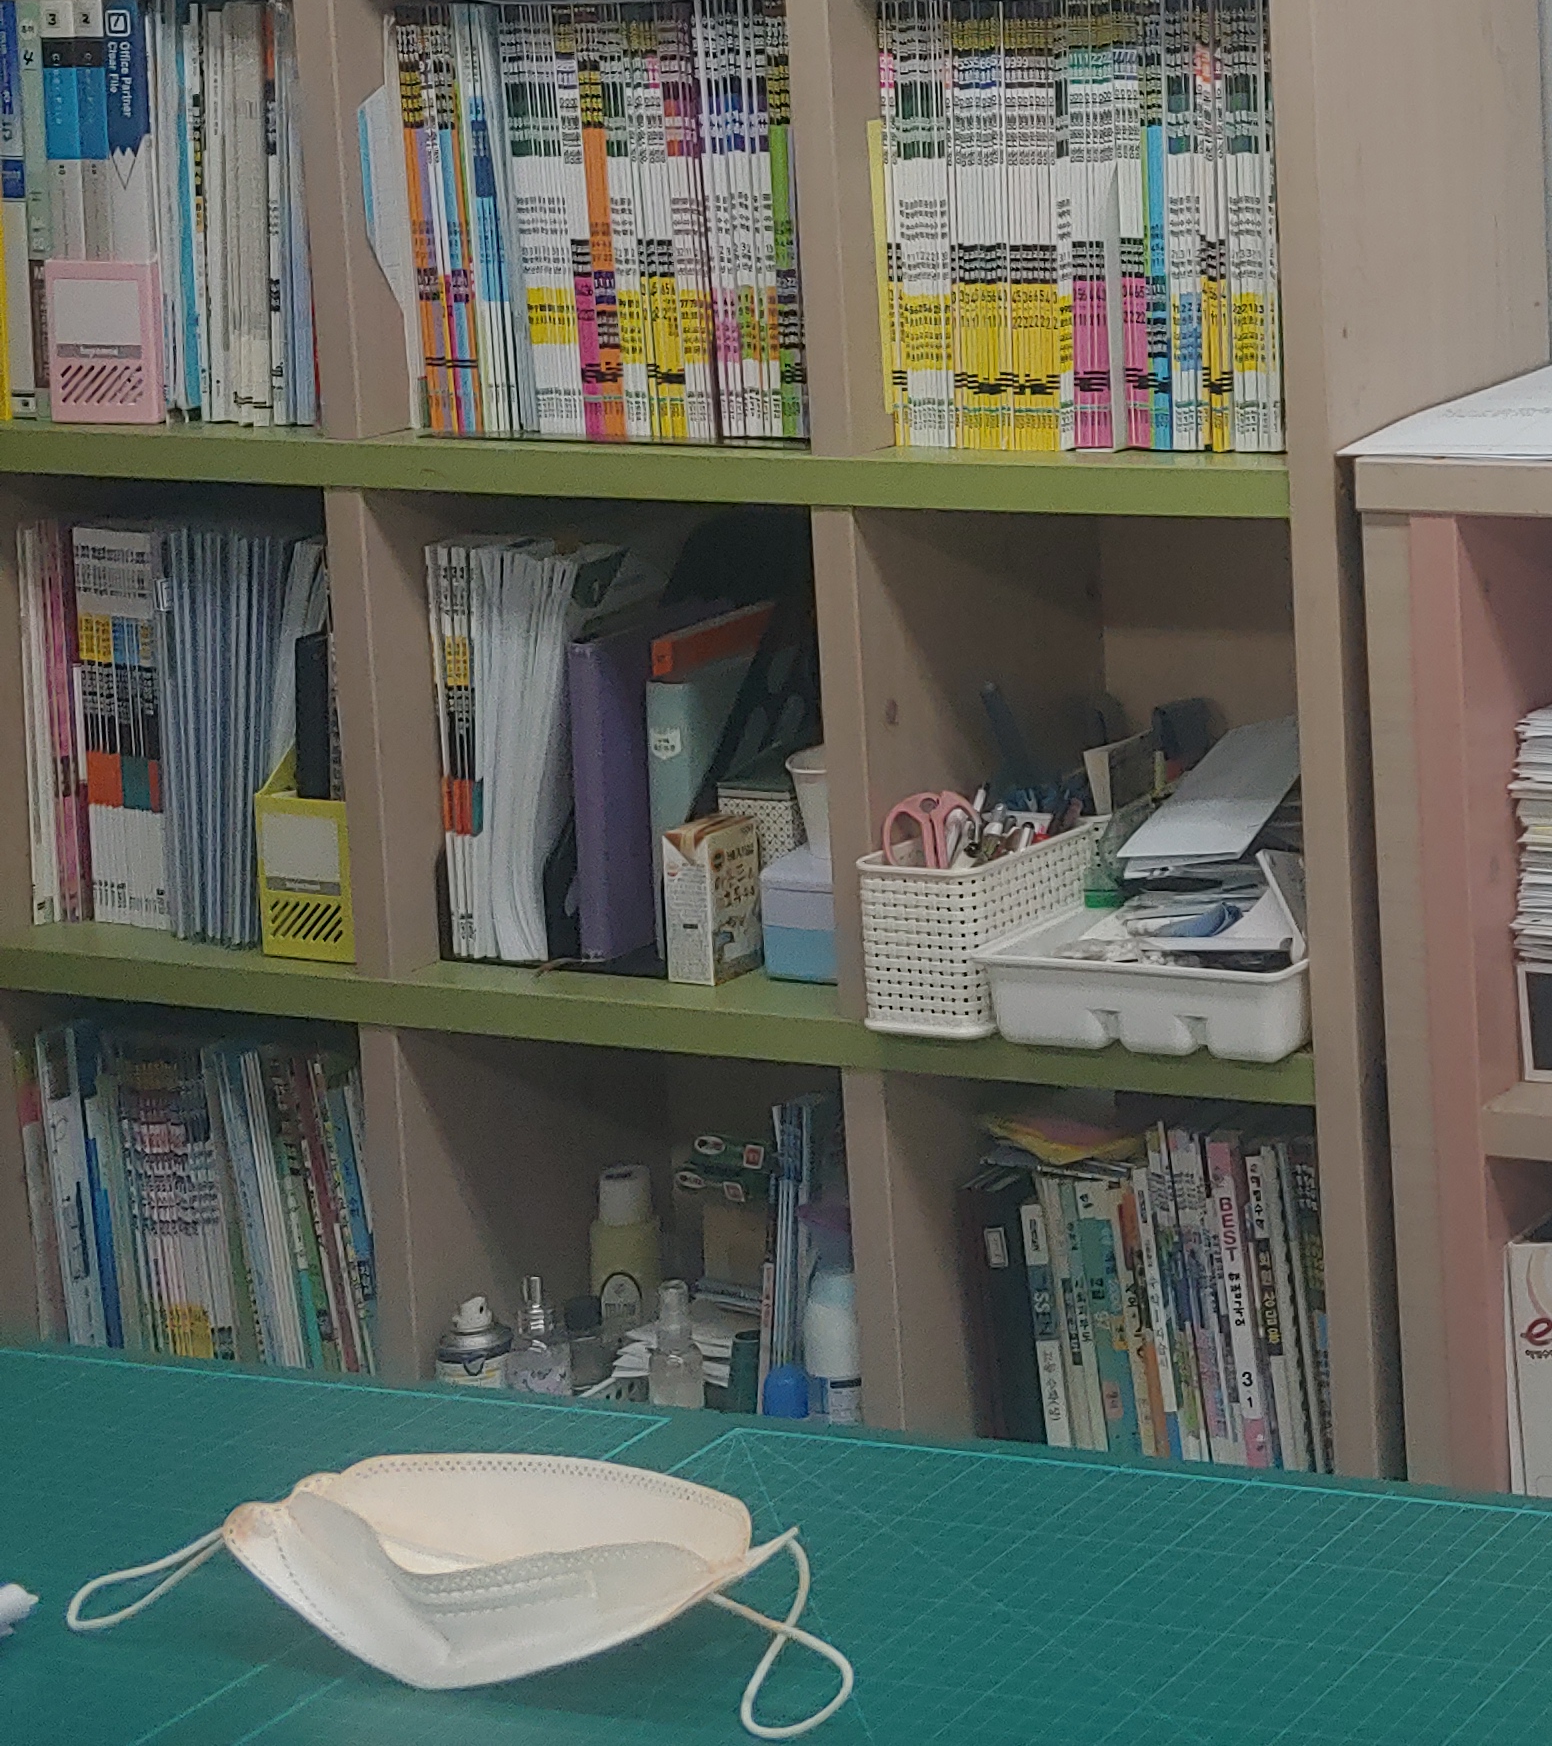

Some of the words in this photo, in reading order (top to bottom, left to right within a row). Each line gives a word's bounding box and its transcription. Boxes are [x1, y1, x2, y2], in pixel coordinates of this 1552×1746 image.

[107, 41, 117, 69] Clear
[118, 41, 131, 73] Office
[120, 75, 133, 119] Partner
[1219, 1196, 1240, 1262] BEST
